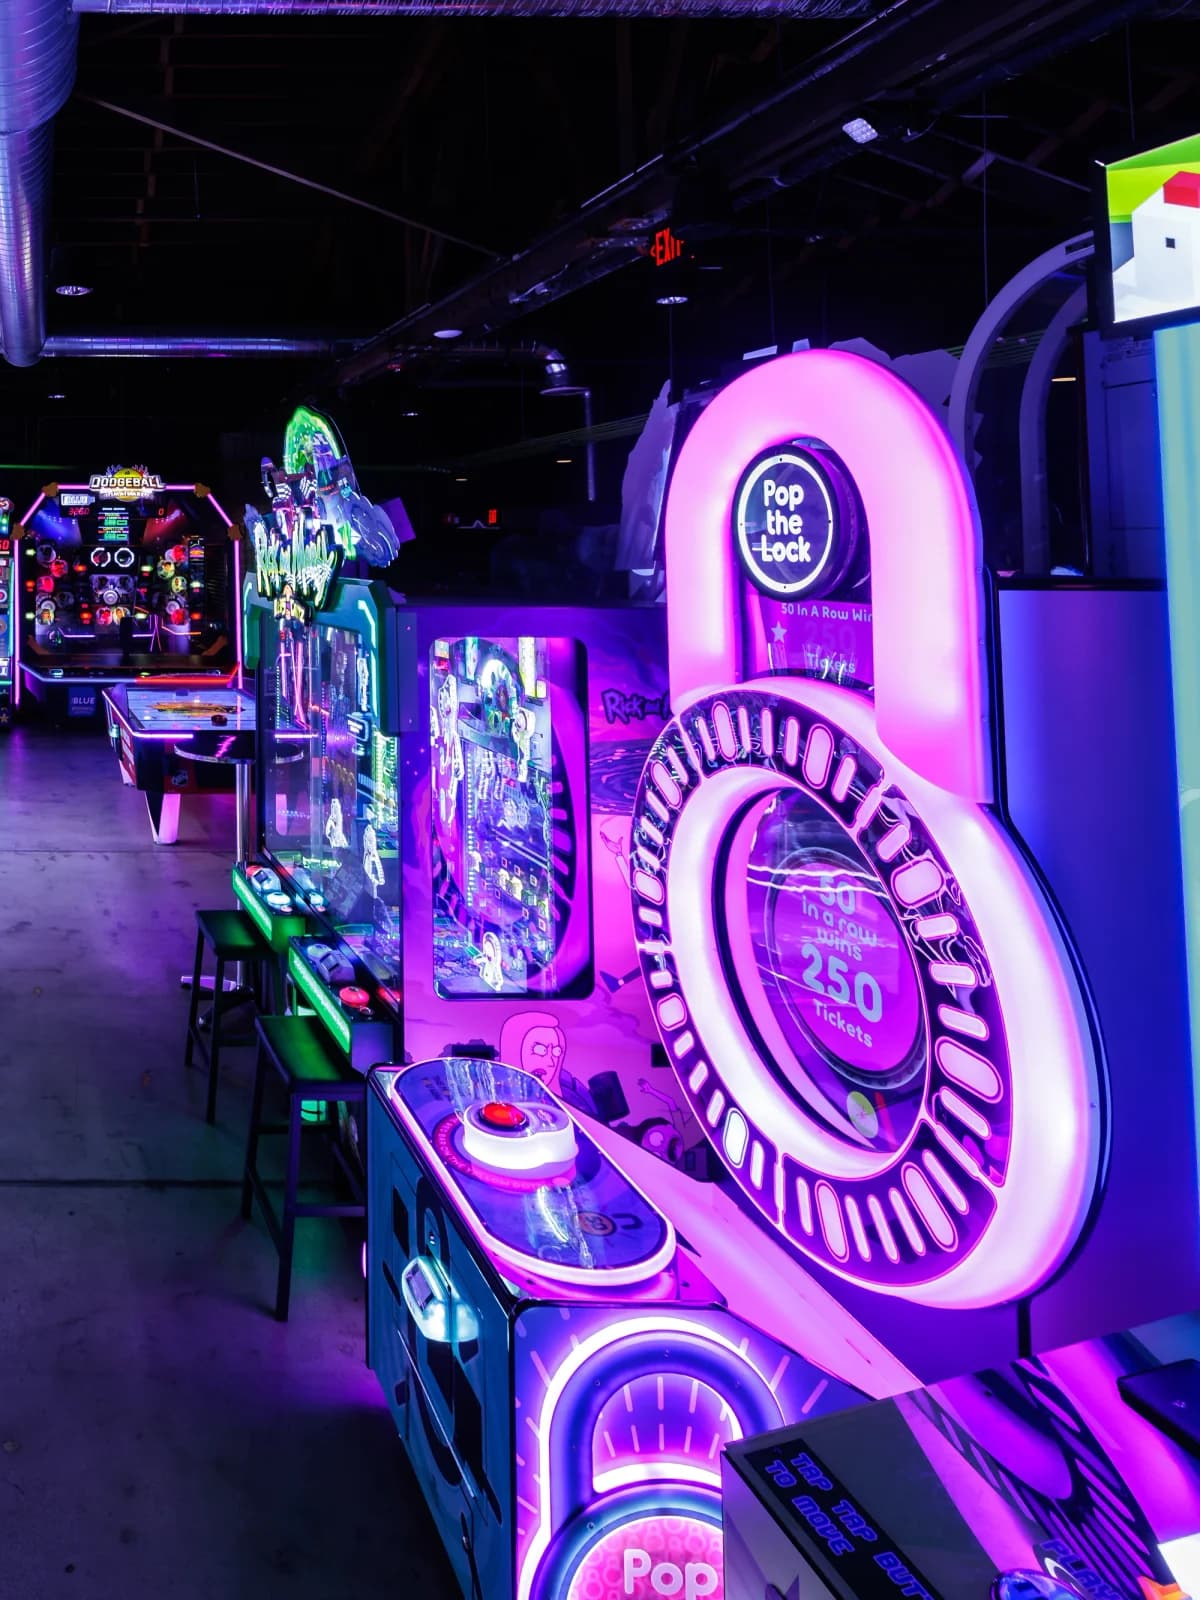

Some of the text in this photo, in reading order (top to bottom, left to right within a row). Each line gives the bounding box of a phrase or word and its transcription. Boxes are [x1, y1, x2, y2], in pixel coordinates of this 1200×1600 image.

[90, 475, 164, 489] DODGEBALL
[763, 480, 804, 512] Pop
[766, 509, 803, 536] the
[760, 534, 812, 563] Lock
[781, 602, 795, 616] 50
[797, 603, 808, 617] In
[810, 604, 820, 617] A
[822, 606, 850, 621] Row
[817, 872, 857, 916] 50
[802, 894, 878, 948] in a row
[817, 927, 864, 962] wins
[801, 942, 882, 1023] 250
[812, 998, 874, 1049] Tickets
[765, 1459, 856, 1557] TO MOVE
[790, 1451, 936, 1600] TAP TAP BUT
[623, 1548, 719, 1600] Pop
